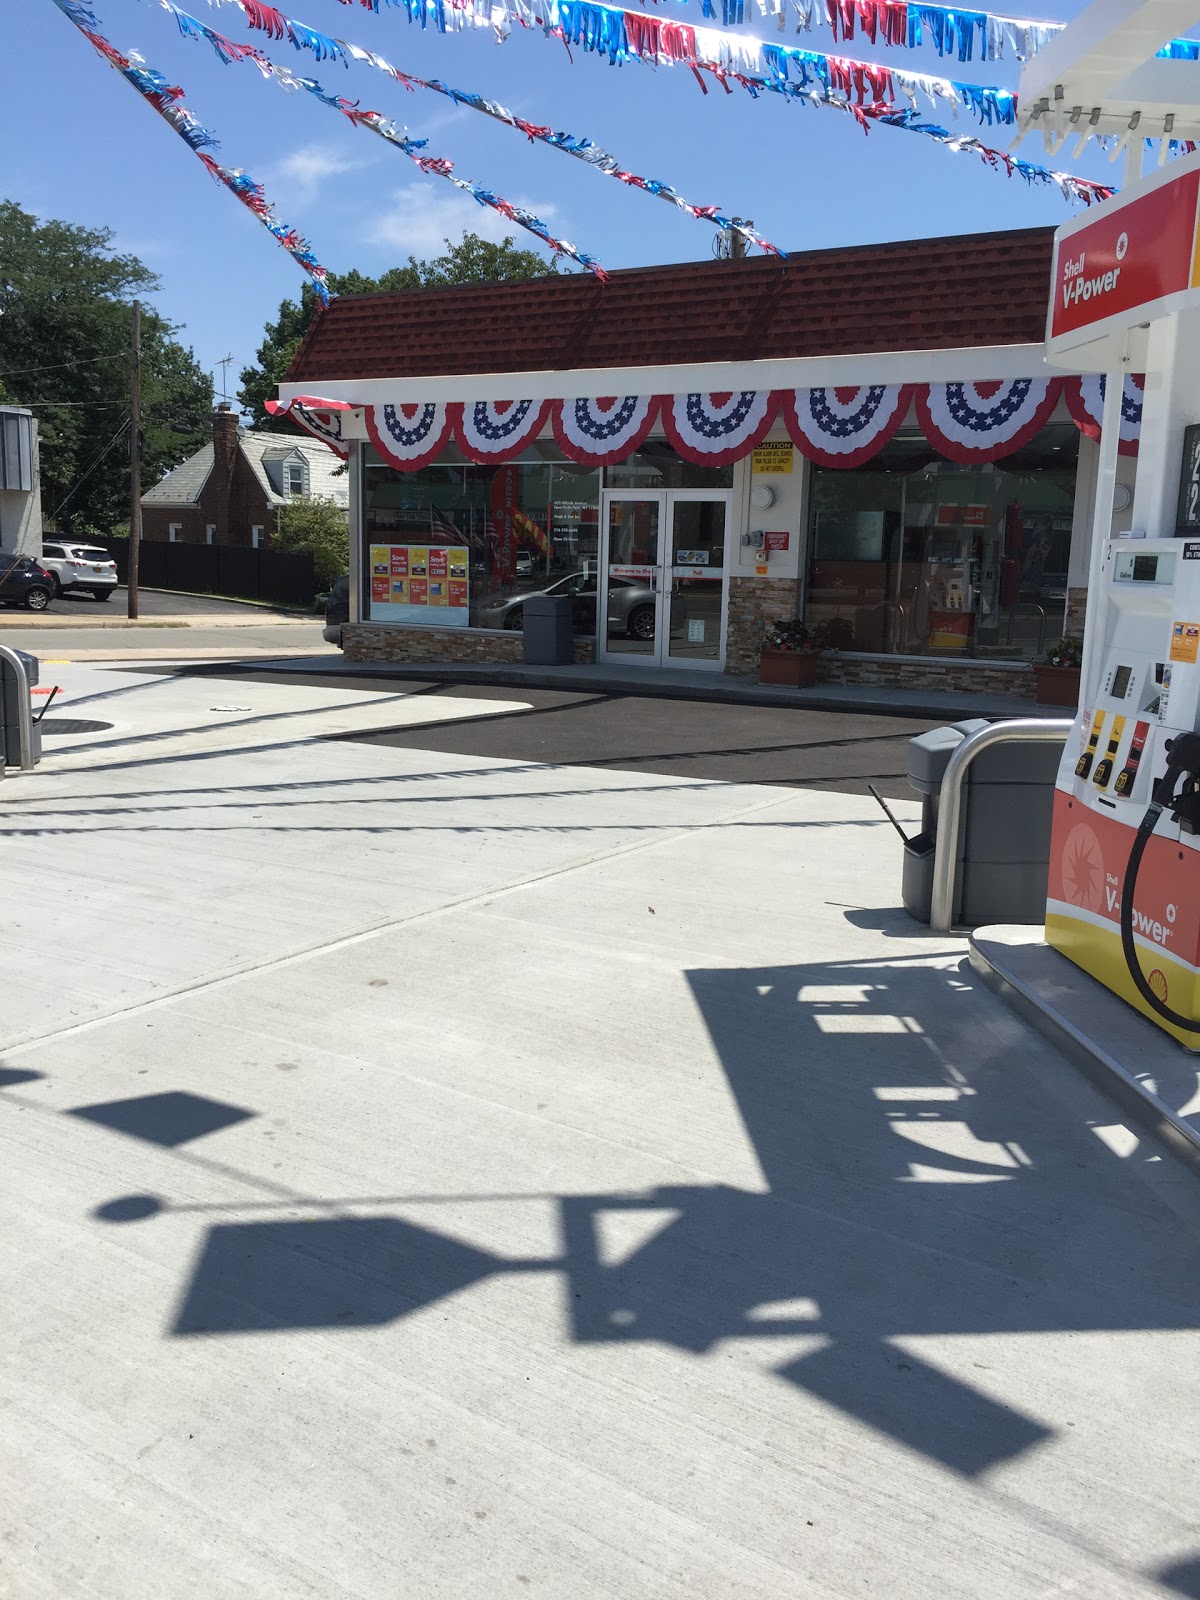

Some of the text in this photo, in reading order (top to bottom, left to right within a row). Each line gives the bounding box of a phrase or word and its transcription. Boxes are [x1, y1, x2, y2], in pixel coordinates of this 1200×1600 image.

[1063, 252, 1086, 281] Shell
[1062, 267, 1121, 309] V-Power
[1106, 873, 1118, 886] Shell
[1106, 885, 1170, 945] V-ower
